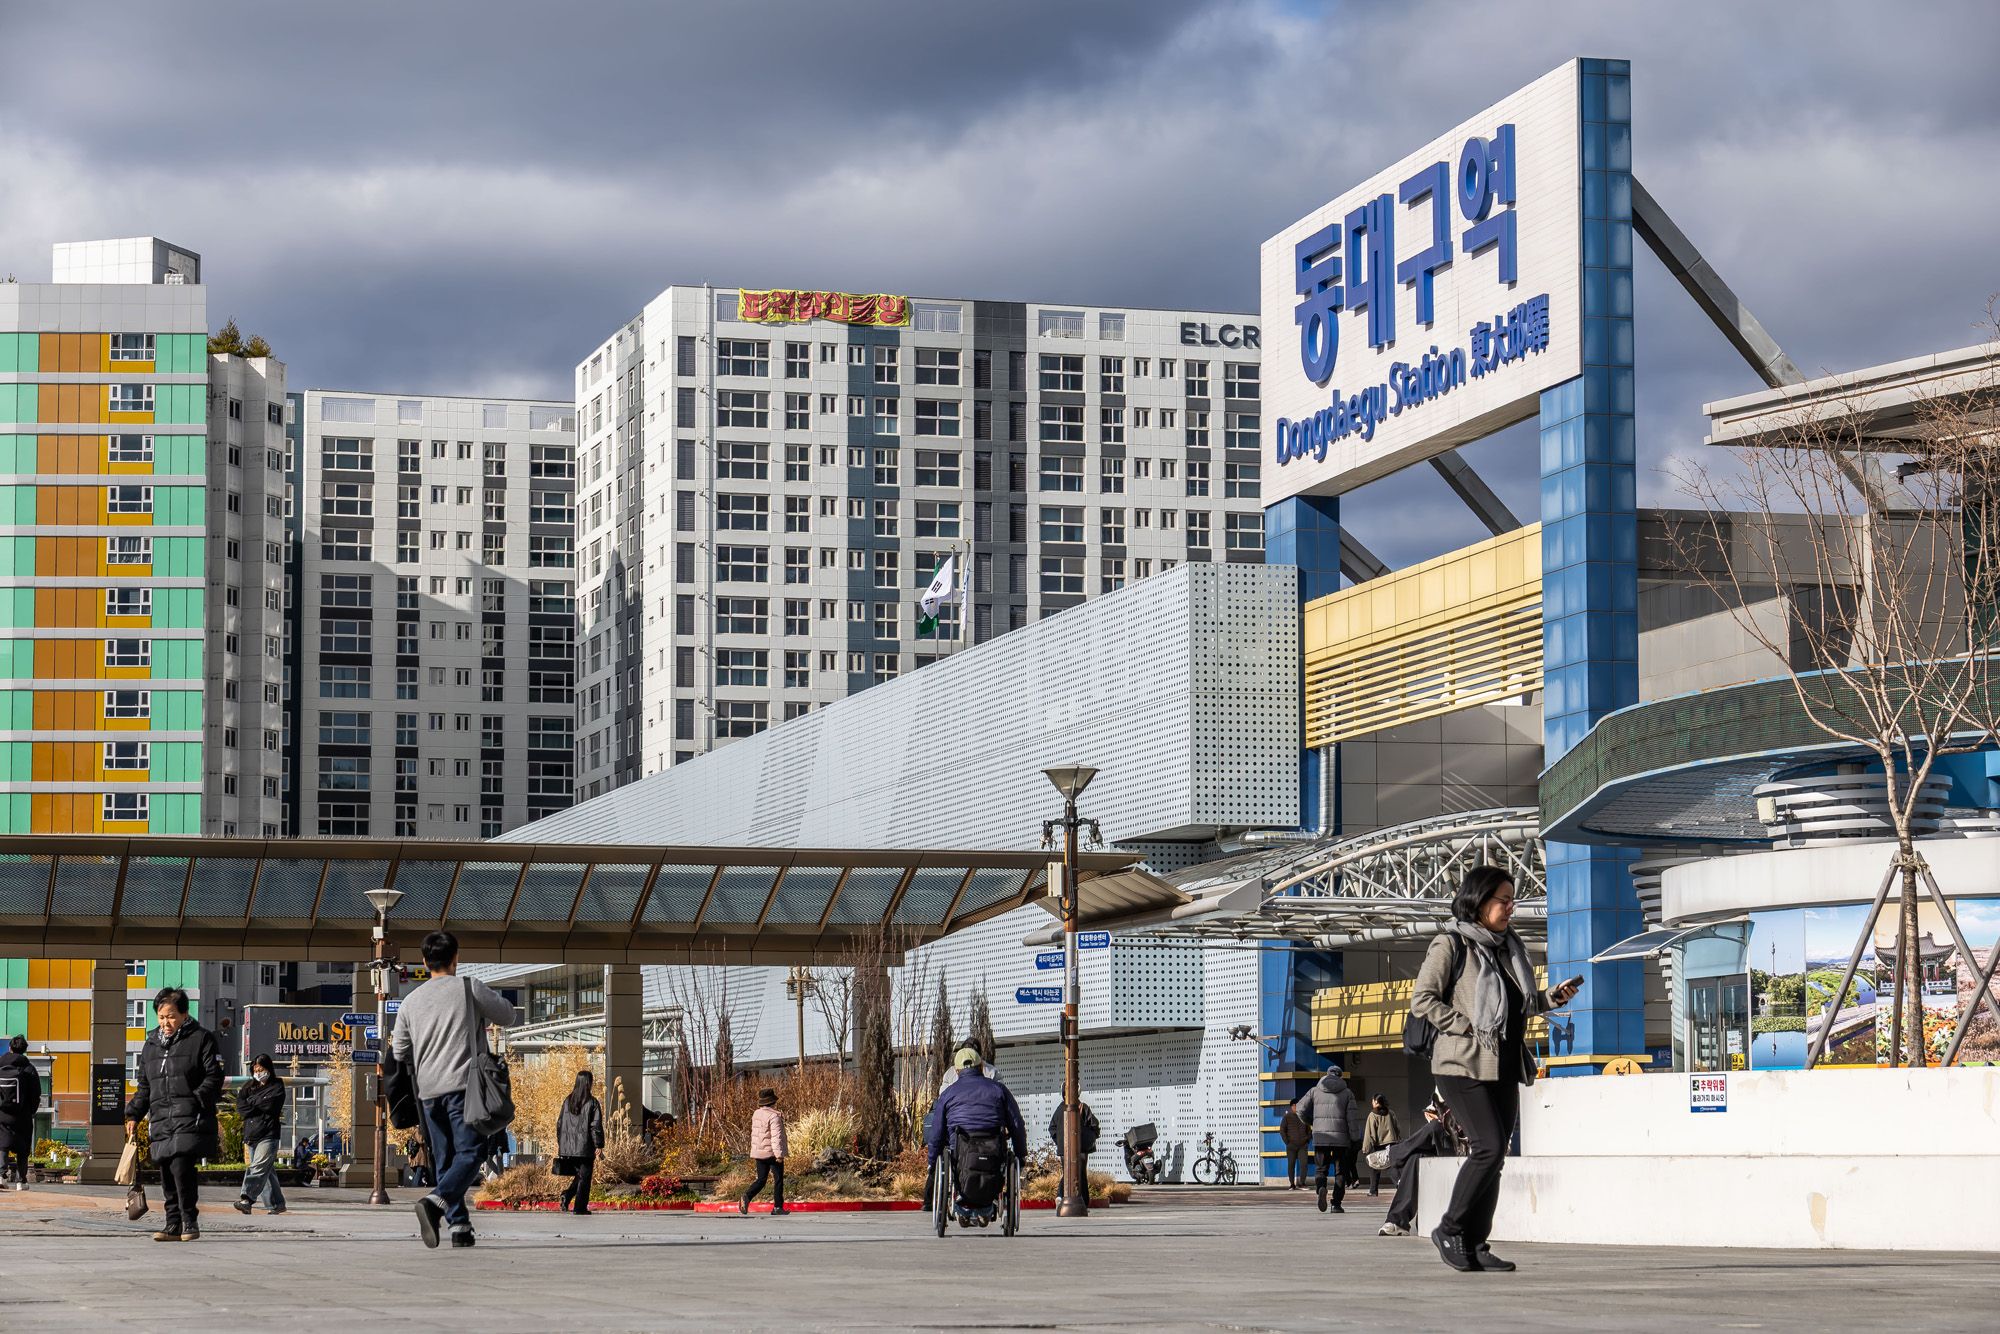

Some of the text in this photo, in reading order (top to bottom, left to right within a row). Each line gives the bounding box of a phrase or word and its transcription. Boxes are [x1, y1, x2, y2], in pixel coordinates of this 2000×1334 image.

[1294, 123, 1517, 384] 동대구역
[1180, 321, 1261, 349] ELCR
[1277, 346, 1466, 465] Dongdaegu Station
[278, 1022, 324, 1040] Motel
[274, 1044, 304, 1054] 최신시설
[1700, 1080, 1724, 1092] 추락위험
[1692, 1094, 1710, 1102] 올라가지
